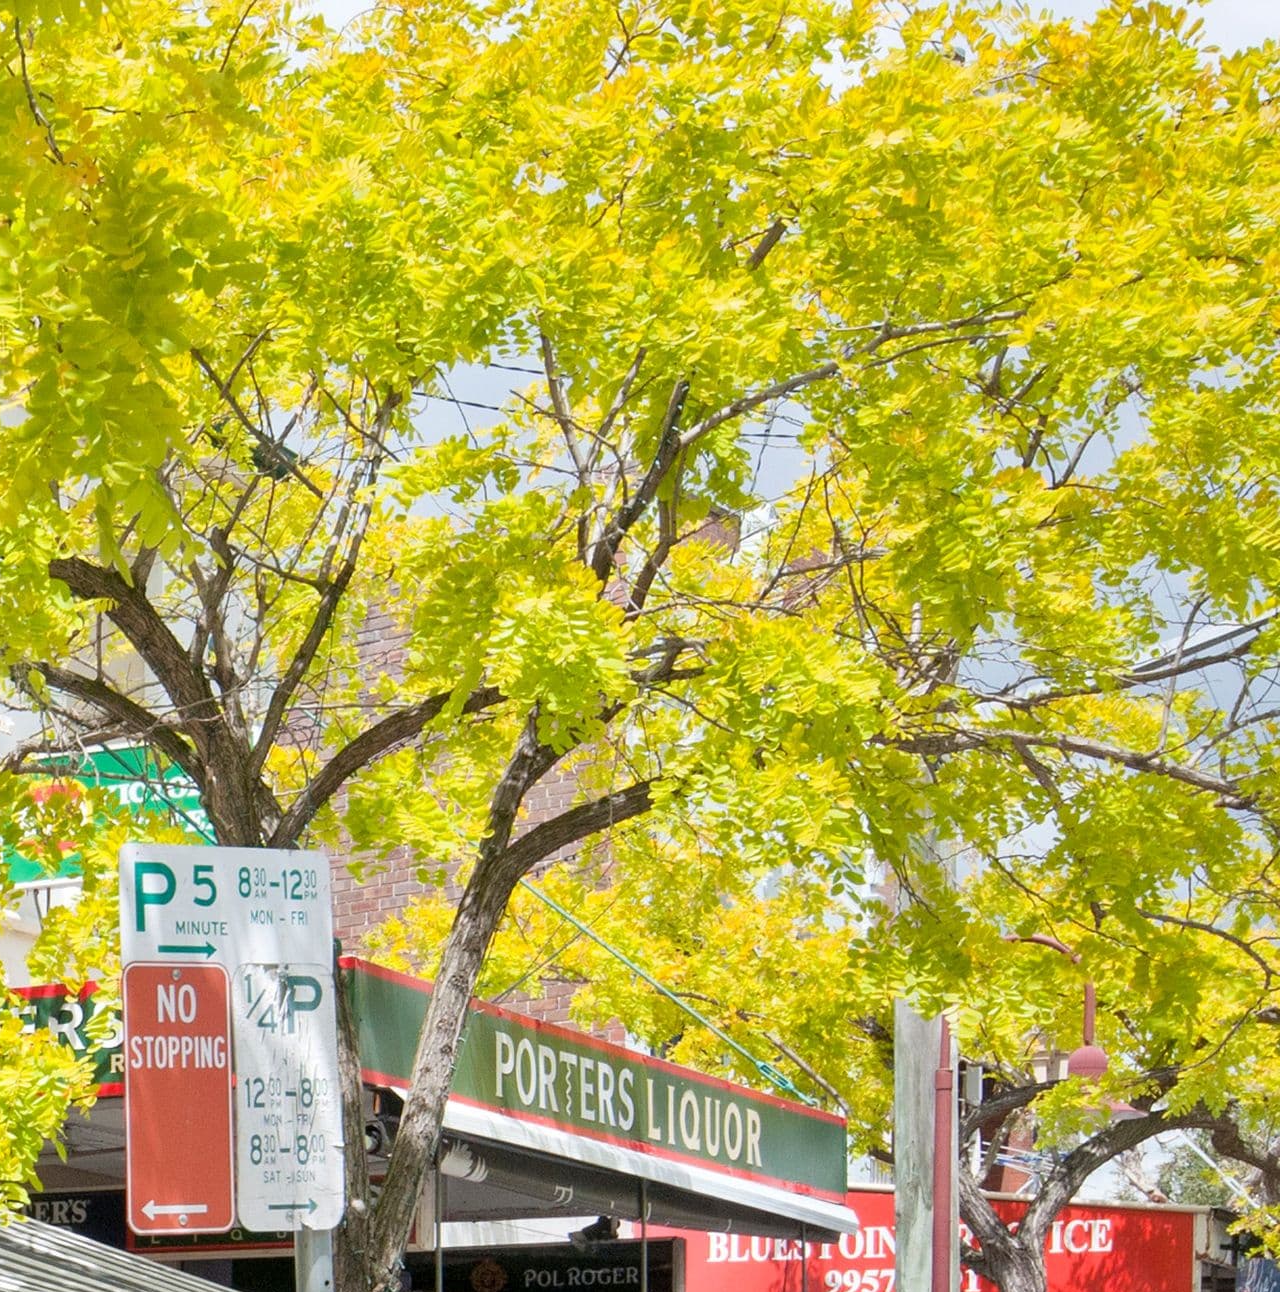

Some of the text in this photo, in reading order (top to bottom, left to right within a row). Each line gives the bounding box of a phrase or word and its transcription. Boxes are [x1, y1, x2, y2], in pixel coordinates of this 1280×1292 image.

[135, 862, 176, 932] P
[193, 865, 217, 907] 5
[175, 921, 228, 936] MINUTE
[250, 910, 308, 925] MON FRI
[157, 984, 196, 1023] NO
[130, 1036, 225, 1069] STOPPING
[495, 1031, 762, 1168] PORTERS LIQUOR
[264, 1170, 281, 1183] SAT
[524, 1266, 639, 1287] POL ROGER
